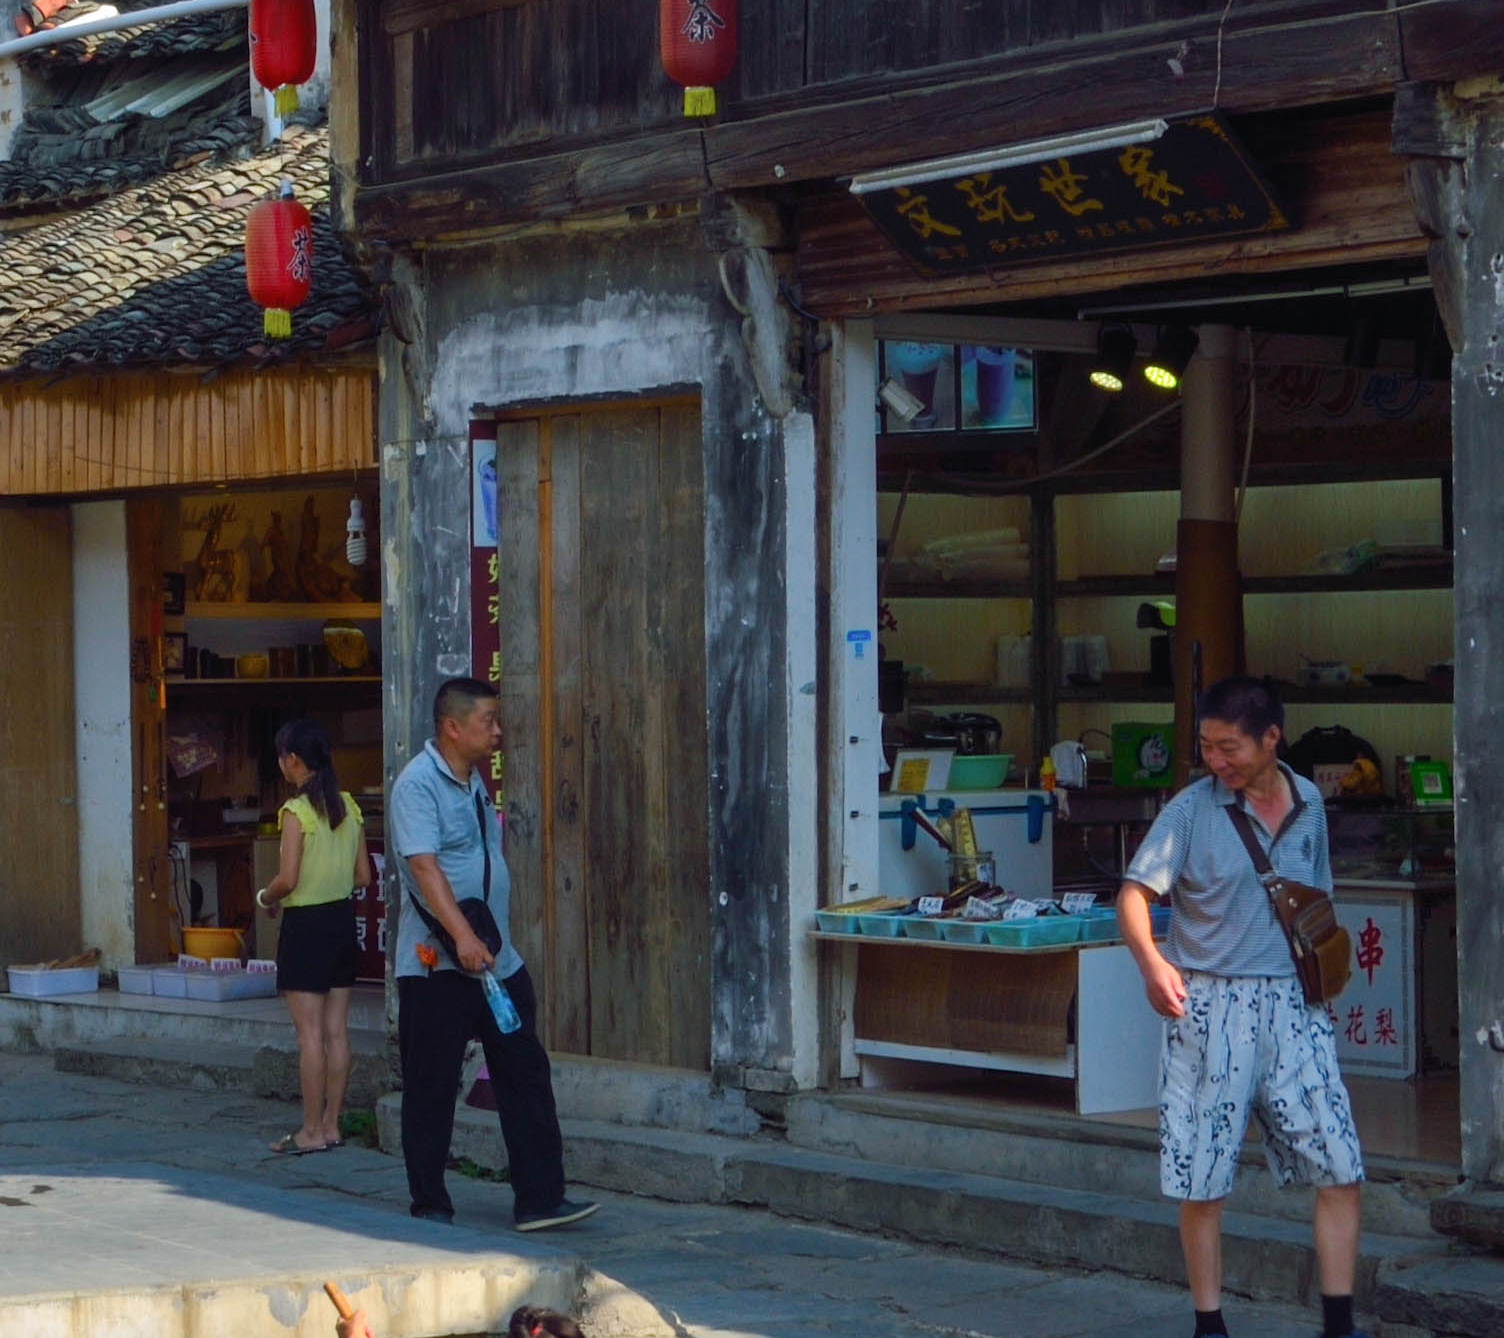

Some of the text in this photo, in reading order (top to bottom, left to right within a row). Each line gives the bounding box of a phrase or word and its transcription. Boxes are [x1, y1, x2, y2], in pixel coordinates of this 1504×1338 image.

[895, 145, 1185, 239] 文玩世家
[288, 229, 312, 284] 茶
[1356, 916, 1385, 988] 串
